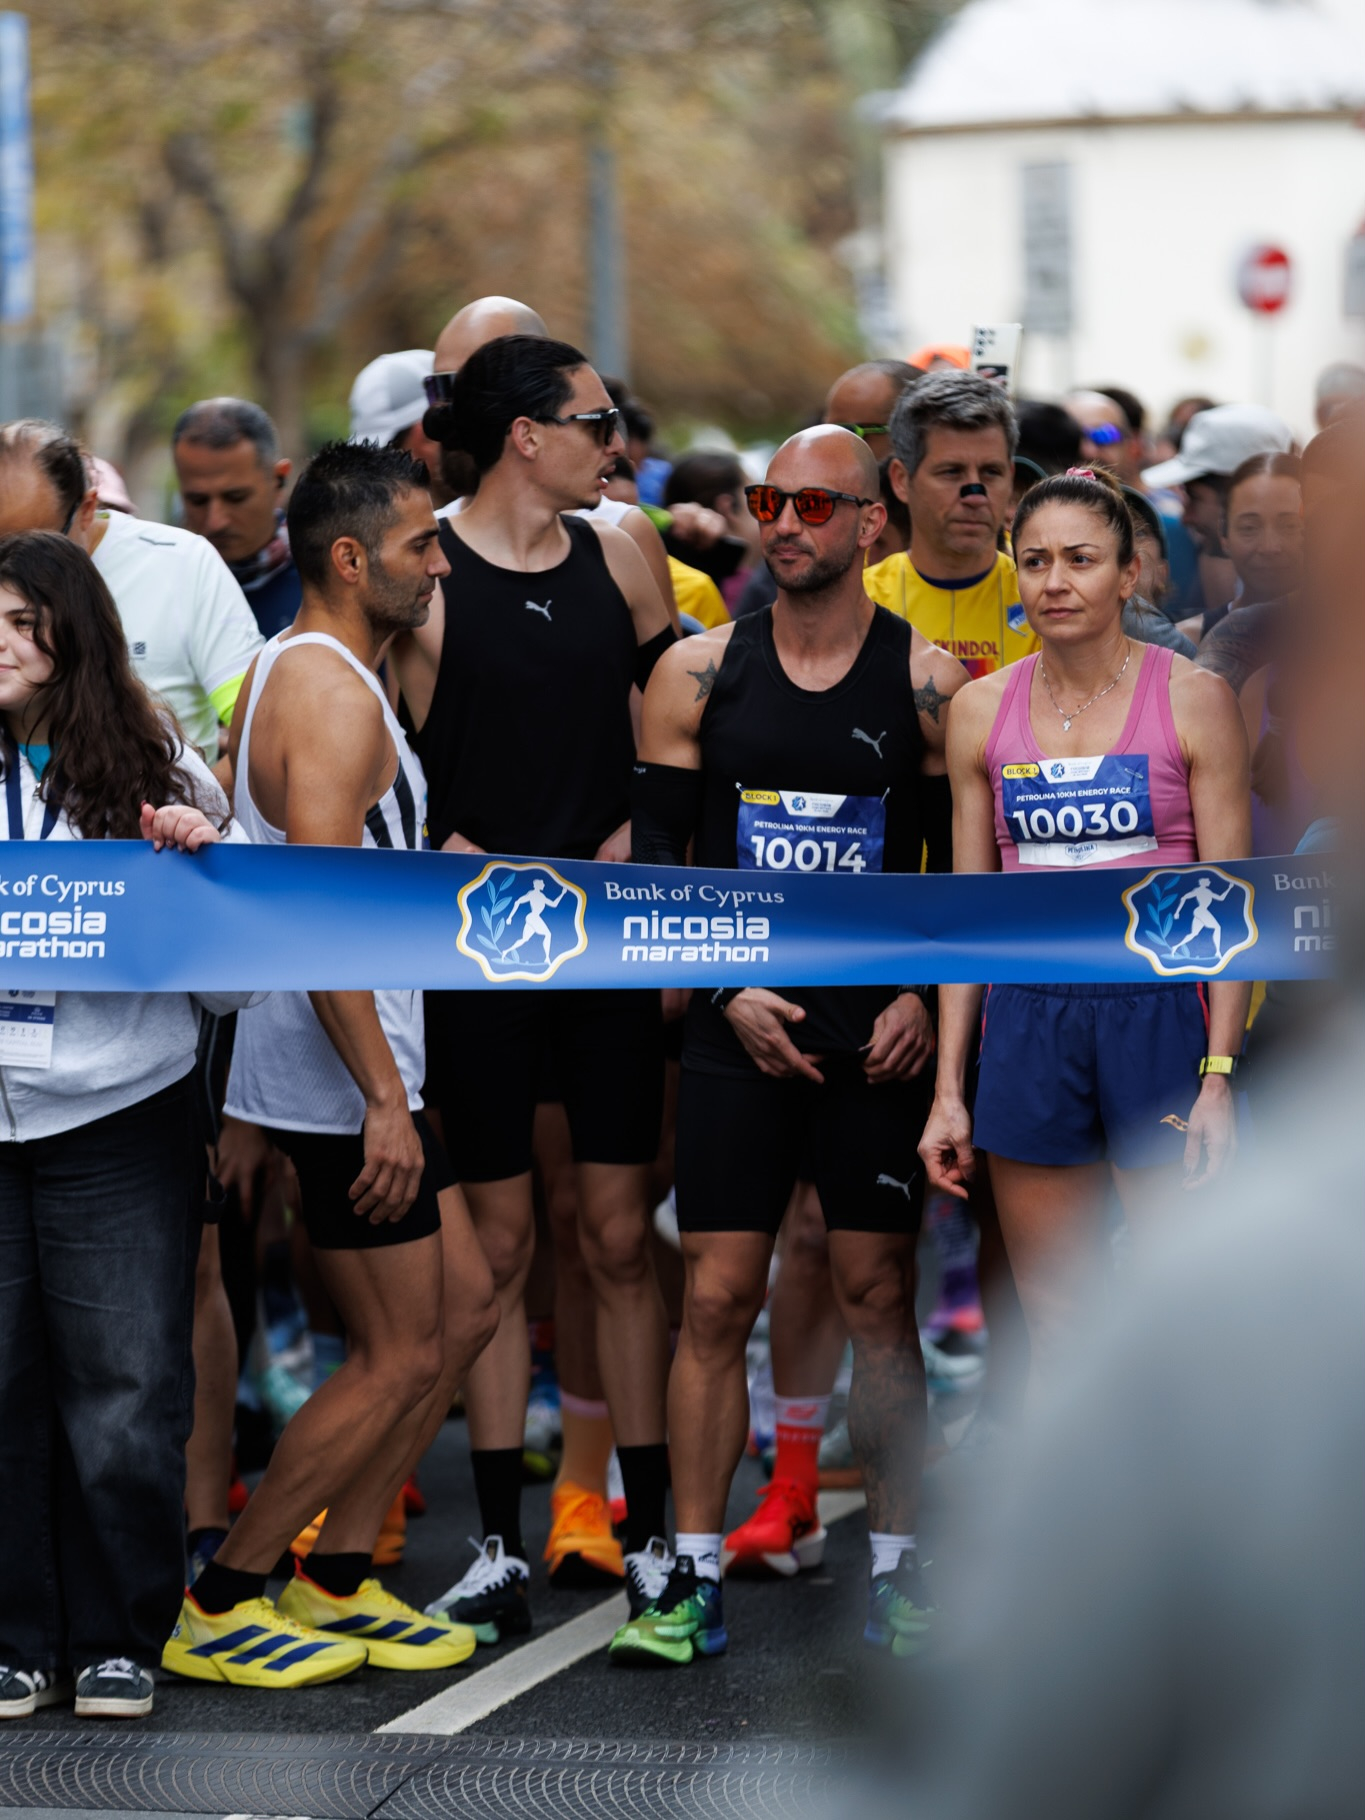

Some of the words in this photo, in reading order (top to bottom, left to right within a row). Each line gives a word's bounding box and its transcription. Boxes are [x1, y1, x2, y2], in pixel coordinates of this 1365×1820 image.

[1006, 767, 1030, 776] BLOCK
[745, 793, 772, 801] BLOCK
[1016, 793, 1056, 803] PETROLINA
[1056, 791, 1077, 799] 10KM
[1077, 787, 1109, 797] ENERGY
[1109, 786, 1131, 795] RACE
[753, 820, 795, 832] PETROLINA
[795, 824, 816, 833] 10KM
[816, 825, 847, 834] ENERGY
[847, 827, 868, 835] RACE
[1012, 800, 1139, 840] 10030
[751, 834, 867, 873] 10014
[12, 874, 38, 897] of
[40, 874, 126, 903] Cyprus
[1272, 871, 1337, 891] Bank
[604, 881, 667, 901] Bank
[670, 884, 694, 901] of
[698, 885, 785, 909] Cyprus
[623, 910, 770, 940] nicosia
[621, 941, 769, 962] marathon
